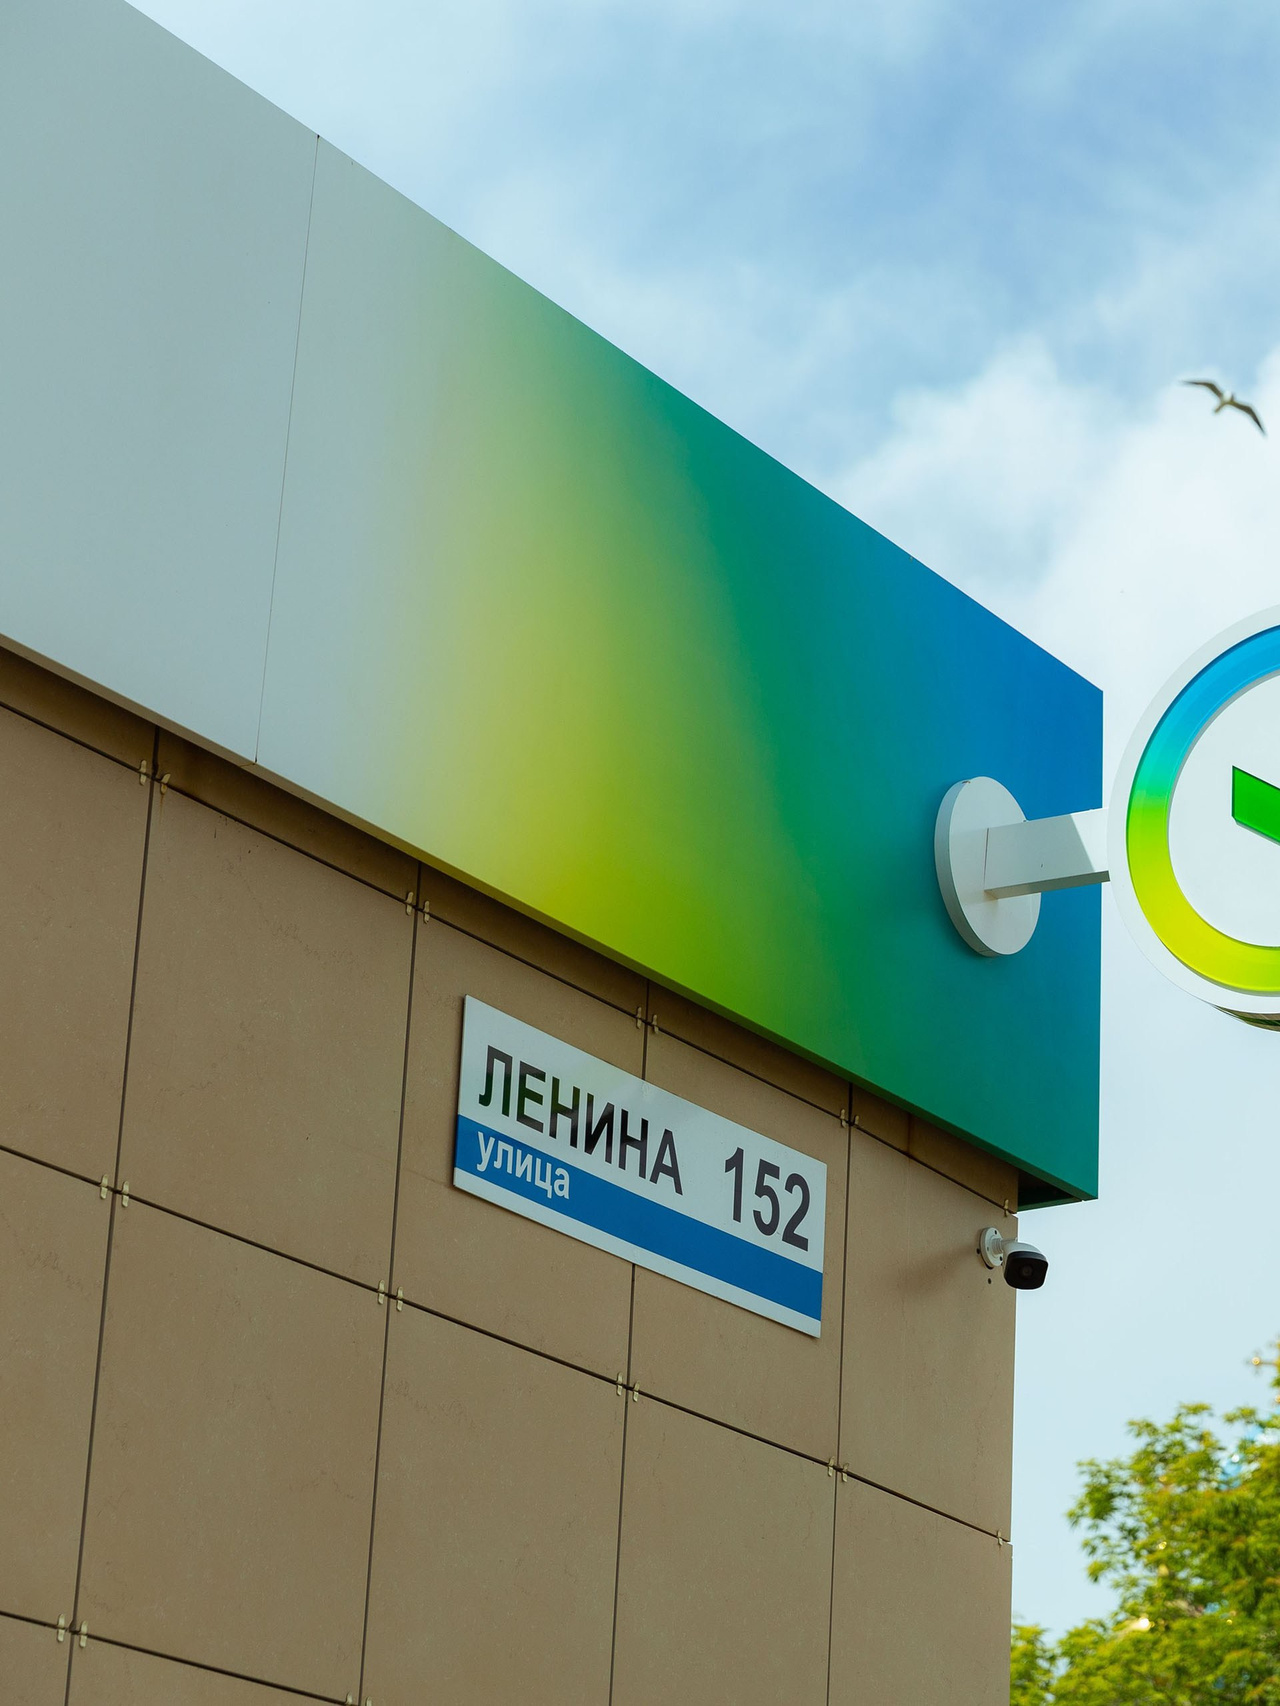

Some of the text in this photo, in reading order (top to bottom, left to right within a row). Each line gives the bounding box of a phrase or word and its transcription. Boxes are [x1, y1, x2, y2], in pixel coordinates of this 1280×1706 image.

[476, 1131, 571, 1199] улица
[478, 1044, 811, 1252] ЛЕНИНА 152
